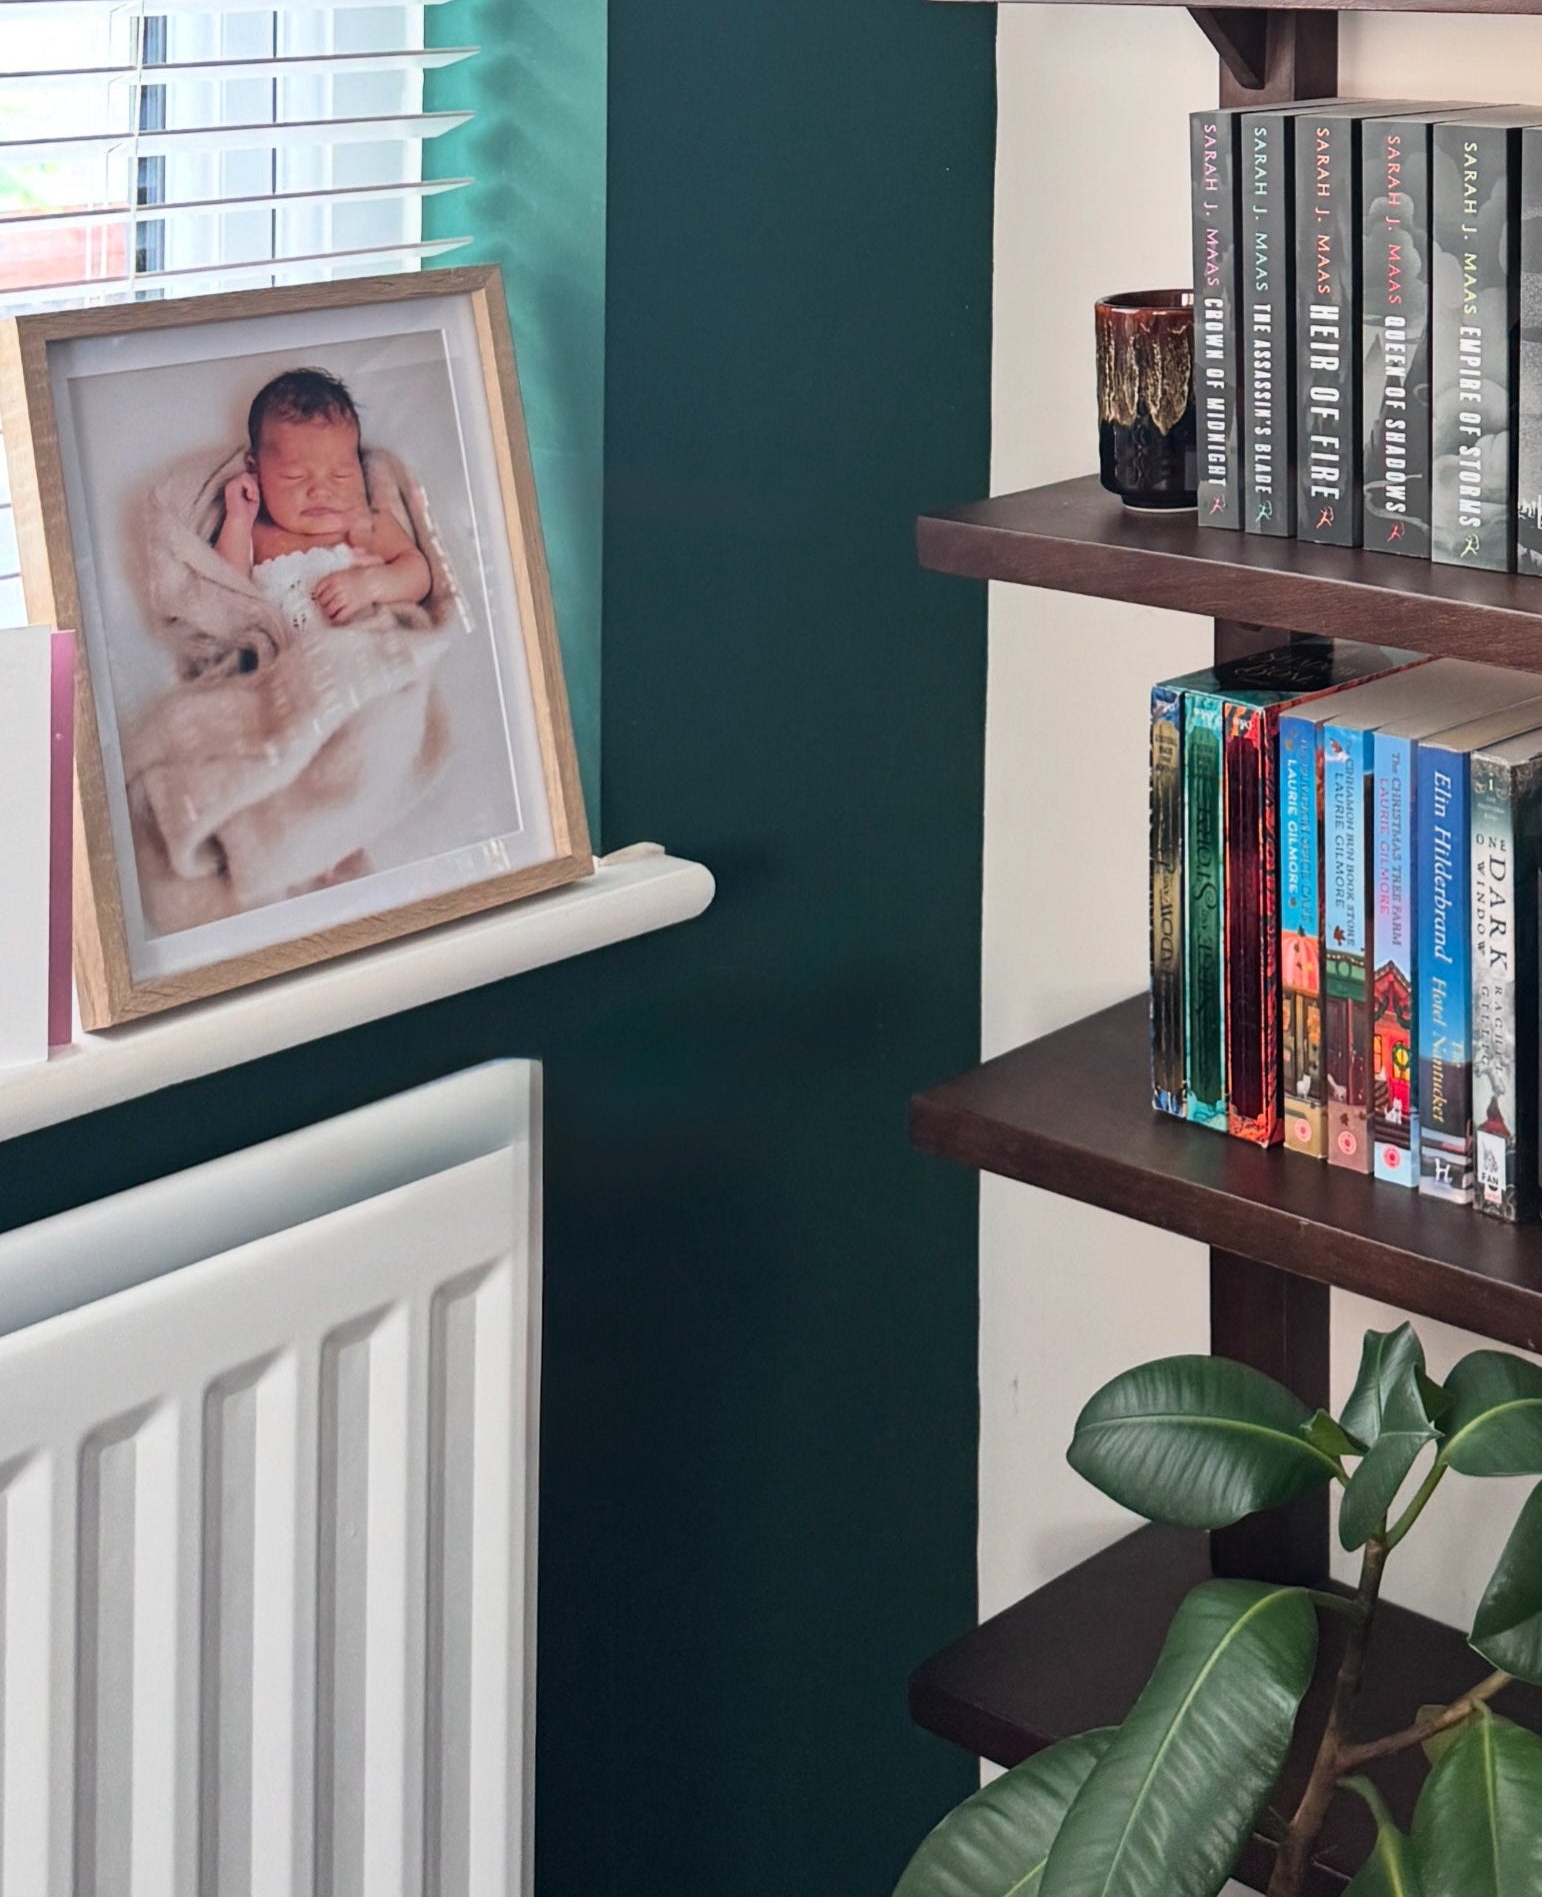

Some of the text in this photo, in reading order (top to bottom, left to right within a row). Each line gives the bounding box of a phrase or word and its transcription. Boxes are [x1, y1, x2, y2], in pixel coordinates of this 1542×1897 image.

[1203, 124, 1220, 288] SARAH MAAS
[1252, 126, 1269, 292] SARAH MAAS
[1315, 127, 1332, 295] SARAH MAAS
[1386, 135, 1402, 306] SARAH MAAS
[1463, 140, 1479, 315] SARAH MAAS
[1203, 297, 1227, 488] CROWN OF MIDNIGHT
[1252, 303, 1272, 495] THE ASSASSIN'S BLADE
[1309, 304, 1341, 501] HEIR OF FIRE
[1384, 314, 1407, 514] QUEEN OF SHADOWS
[1459, 325, 1482, 529] EMPIRE OF STORMS
[1287, 758, 1299, 894] LAURIE GILMORE
[1335, 772, 1346, 909] LAURIE GILMORE
[1346, 832, 1355, 862] BUN
[1346, 864, 1355, 901] BOOK
[1379, 777, 1391, 915] LAURIE GILMORE
[1392, 777, 1403, 861] CHRISTMAS
[1392, 864, 1402, 901] TREE
[1433, 770, 1453, 964] Elin Hilderbrand
[1347, 904, 1356, 947] STORE
[1392, 905, 1403, 946] FARM
[1476, 860, 1487, 956] WINDOW
[1489, 855, 1508, 972] DARK
[1431, 976, 1448, 1124] Hotel Nantucket
